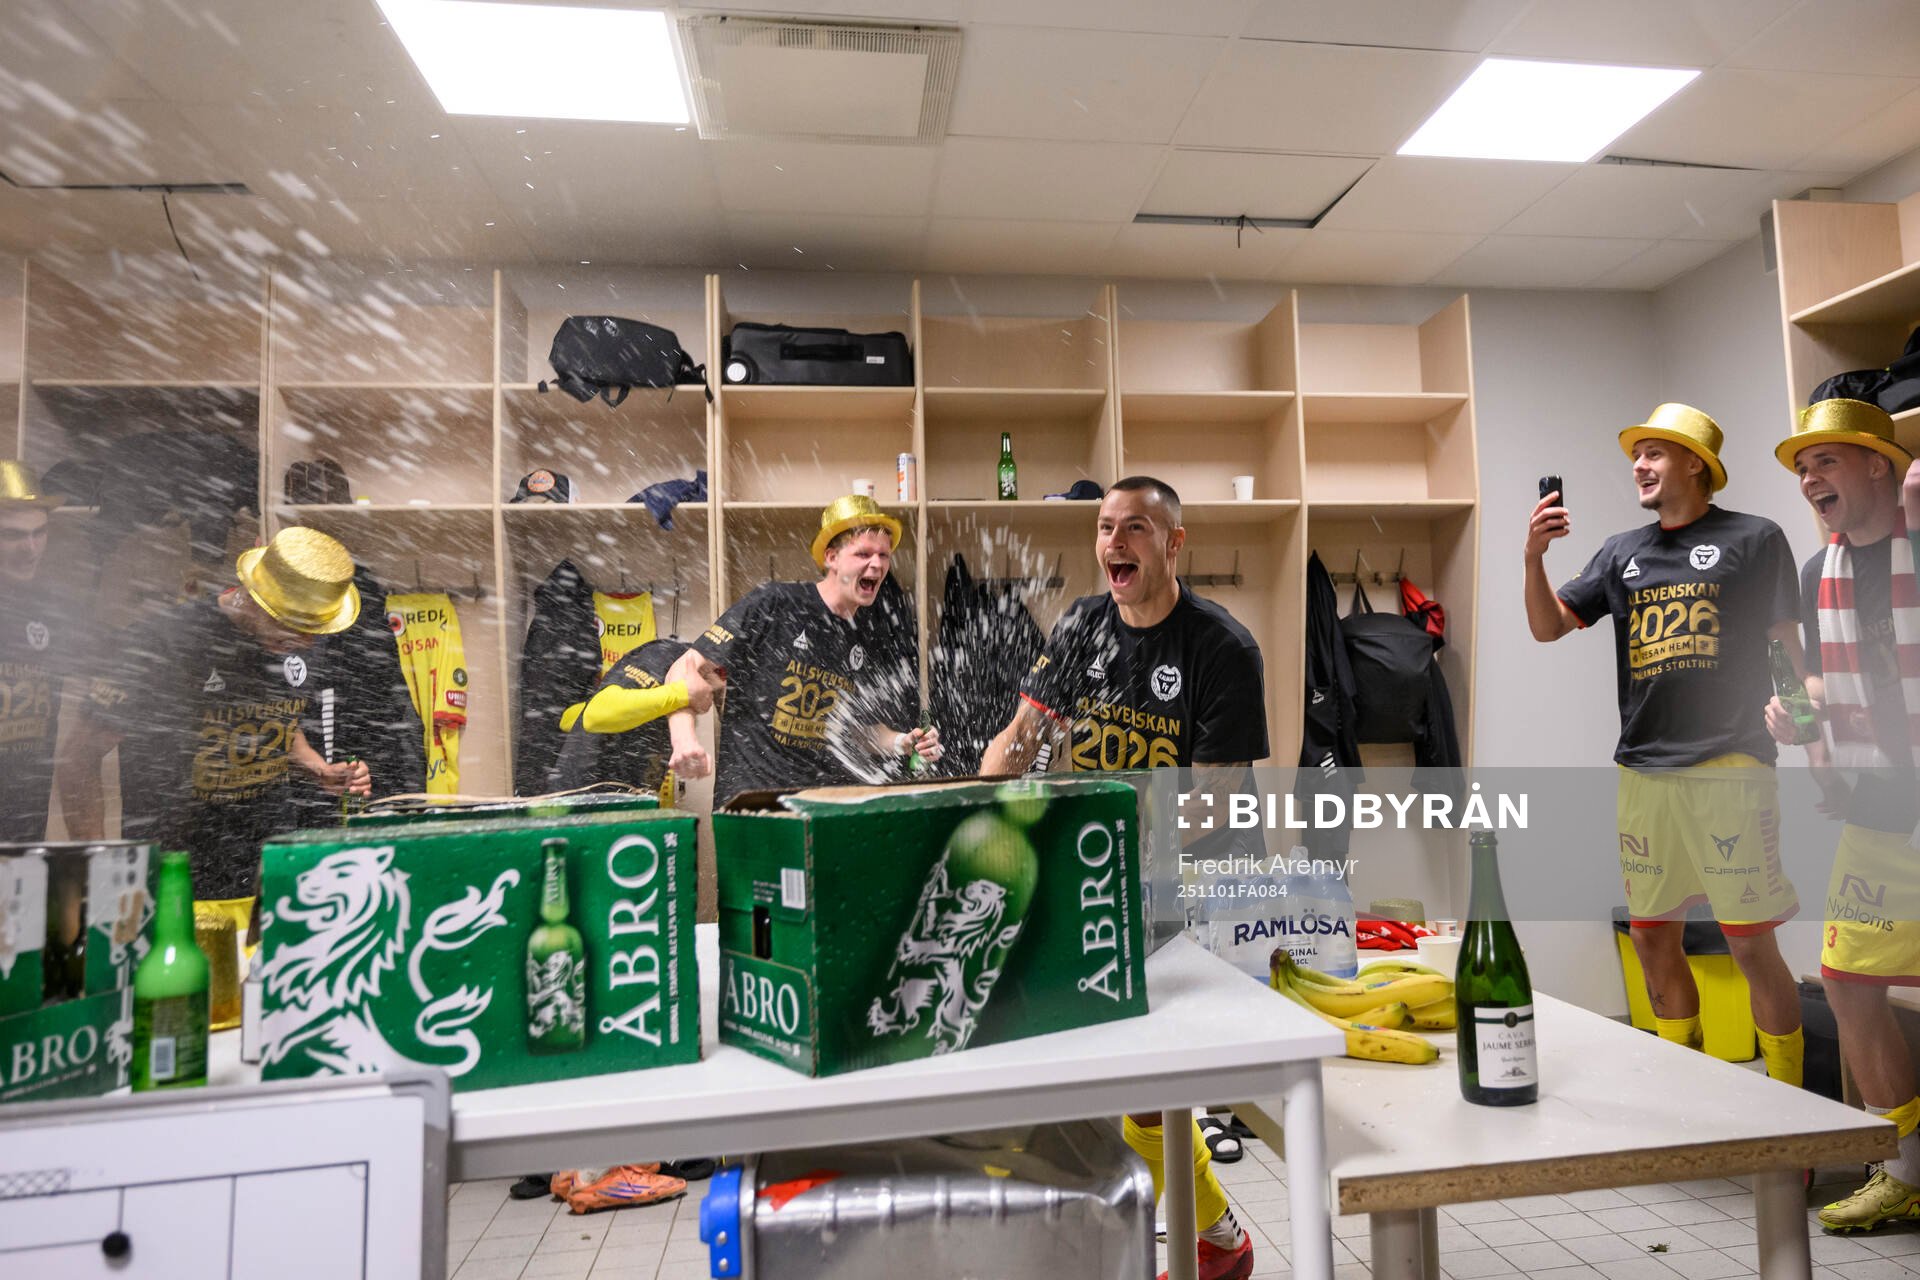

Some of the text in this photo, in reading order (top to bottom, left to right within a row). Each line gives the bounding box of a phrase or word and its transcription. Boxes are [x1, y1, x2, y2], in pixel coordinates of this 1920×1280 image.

[1669, 640, 1690, 652] HEM
[1665, 659, 1719, 672] STOLTHET
[1704, 866, 1760, 876] CUPRA
[1077, 821, 1120, 1002] ÅBRO
[1234, 908, 1350, 946] RAMLÖSA
[1827, 895, 1895, 932] Nybloms
[599, 834, 662, 1047] ÅBRO
[723, 959, 800, 1035] ÅBRO
[0, 1025, 98, 1087] BRO
[1482, 1040, 1512, 1051] JAUME
